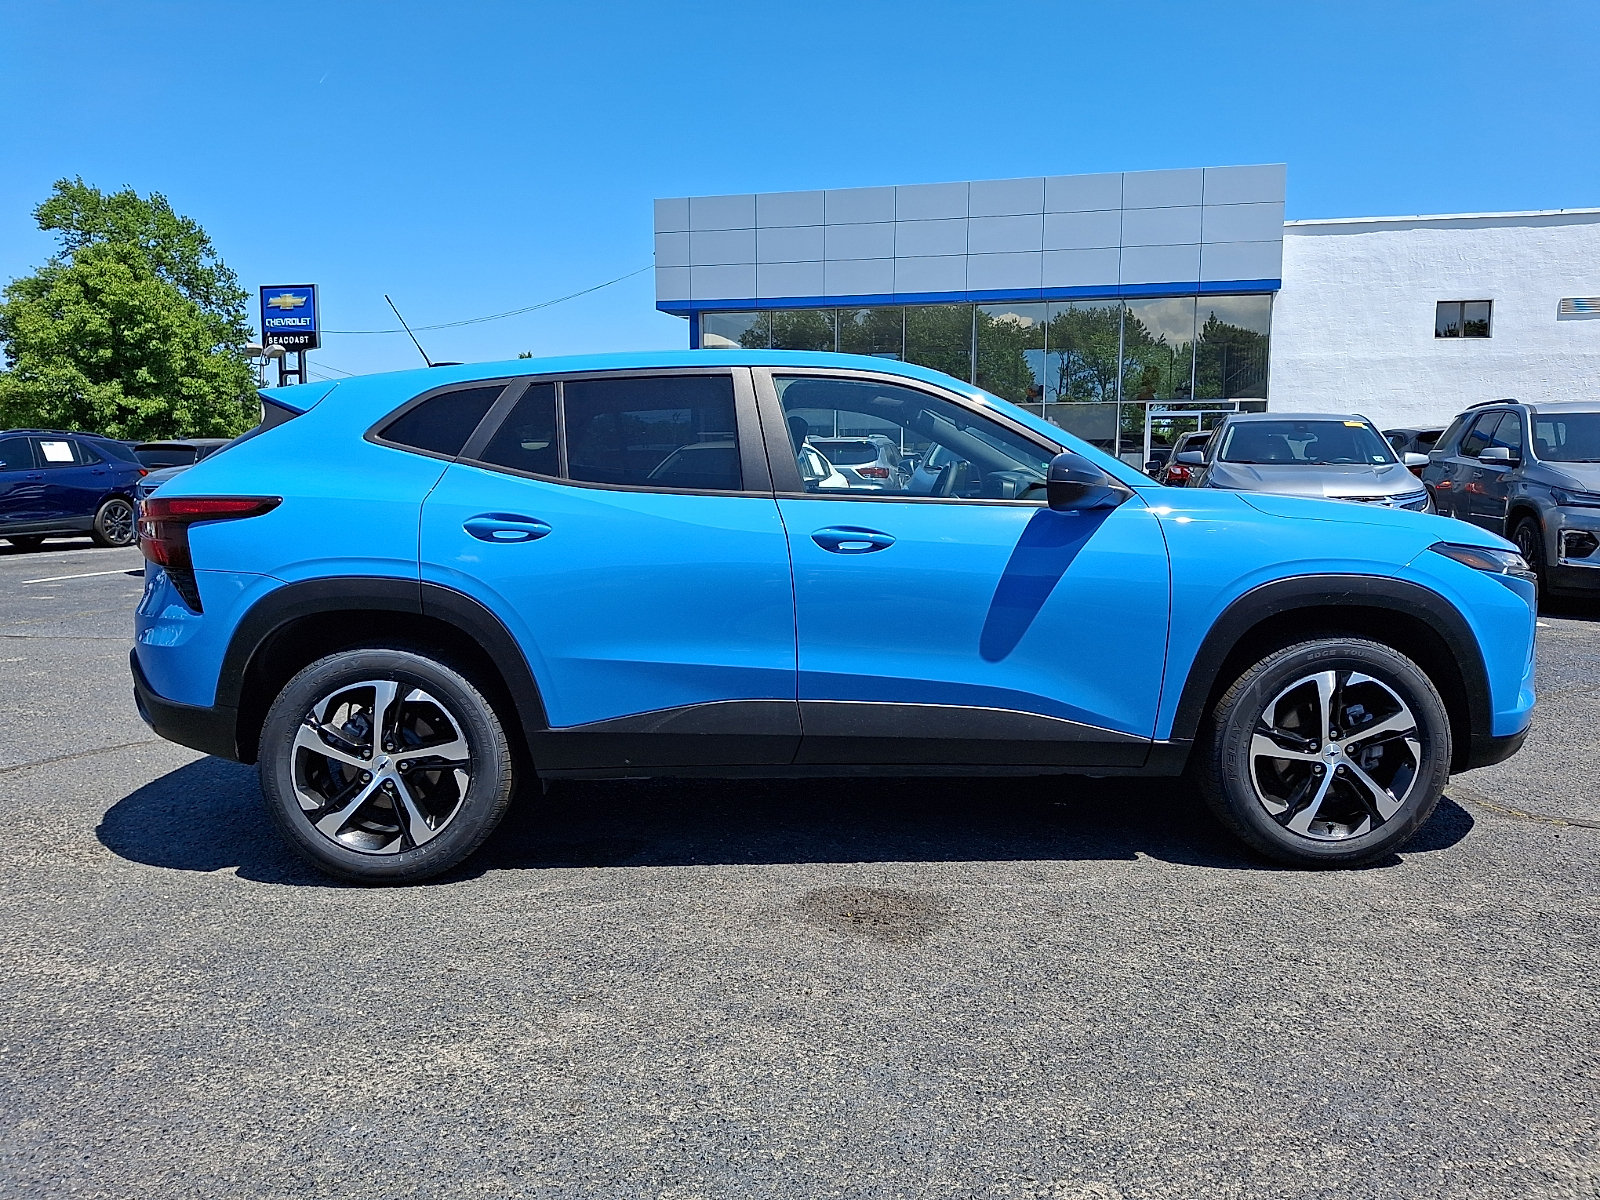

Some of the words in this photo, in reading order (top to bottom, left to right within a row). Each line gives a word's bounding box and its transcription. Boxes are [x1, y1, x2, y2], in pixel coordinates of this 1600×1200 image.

[265, 317, 311, 326] CHEVROLET
[268, 336, 309, 344] SEACOAST
[1306, 649, 1337, 661] EDGE
